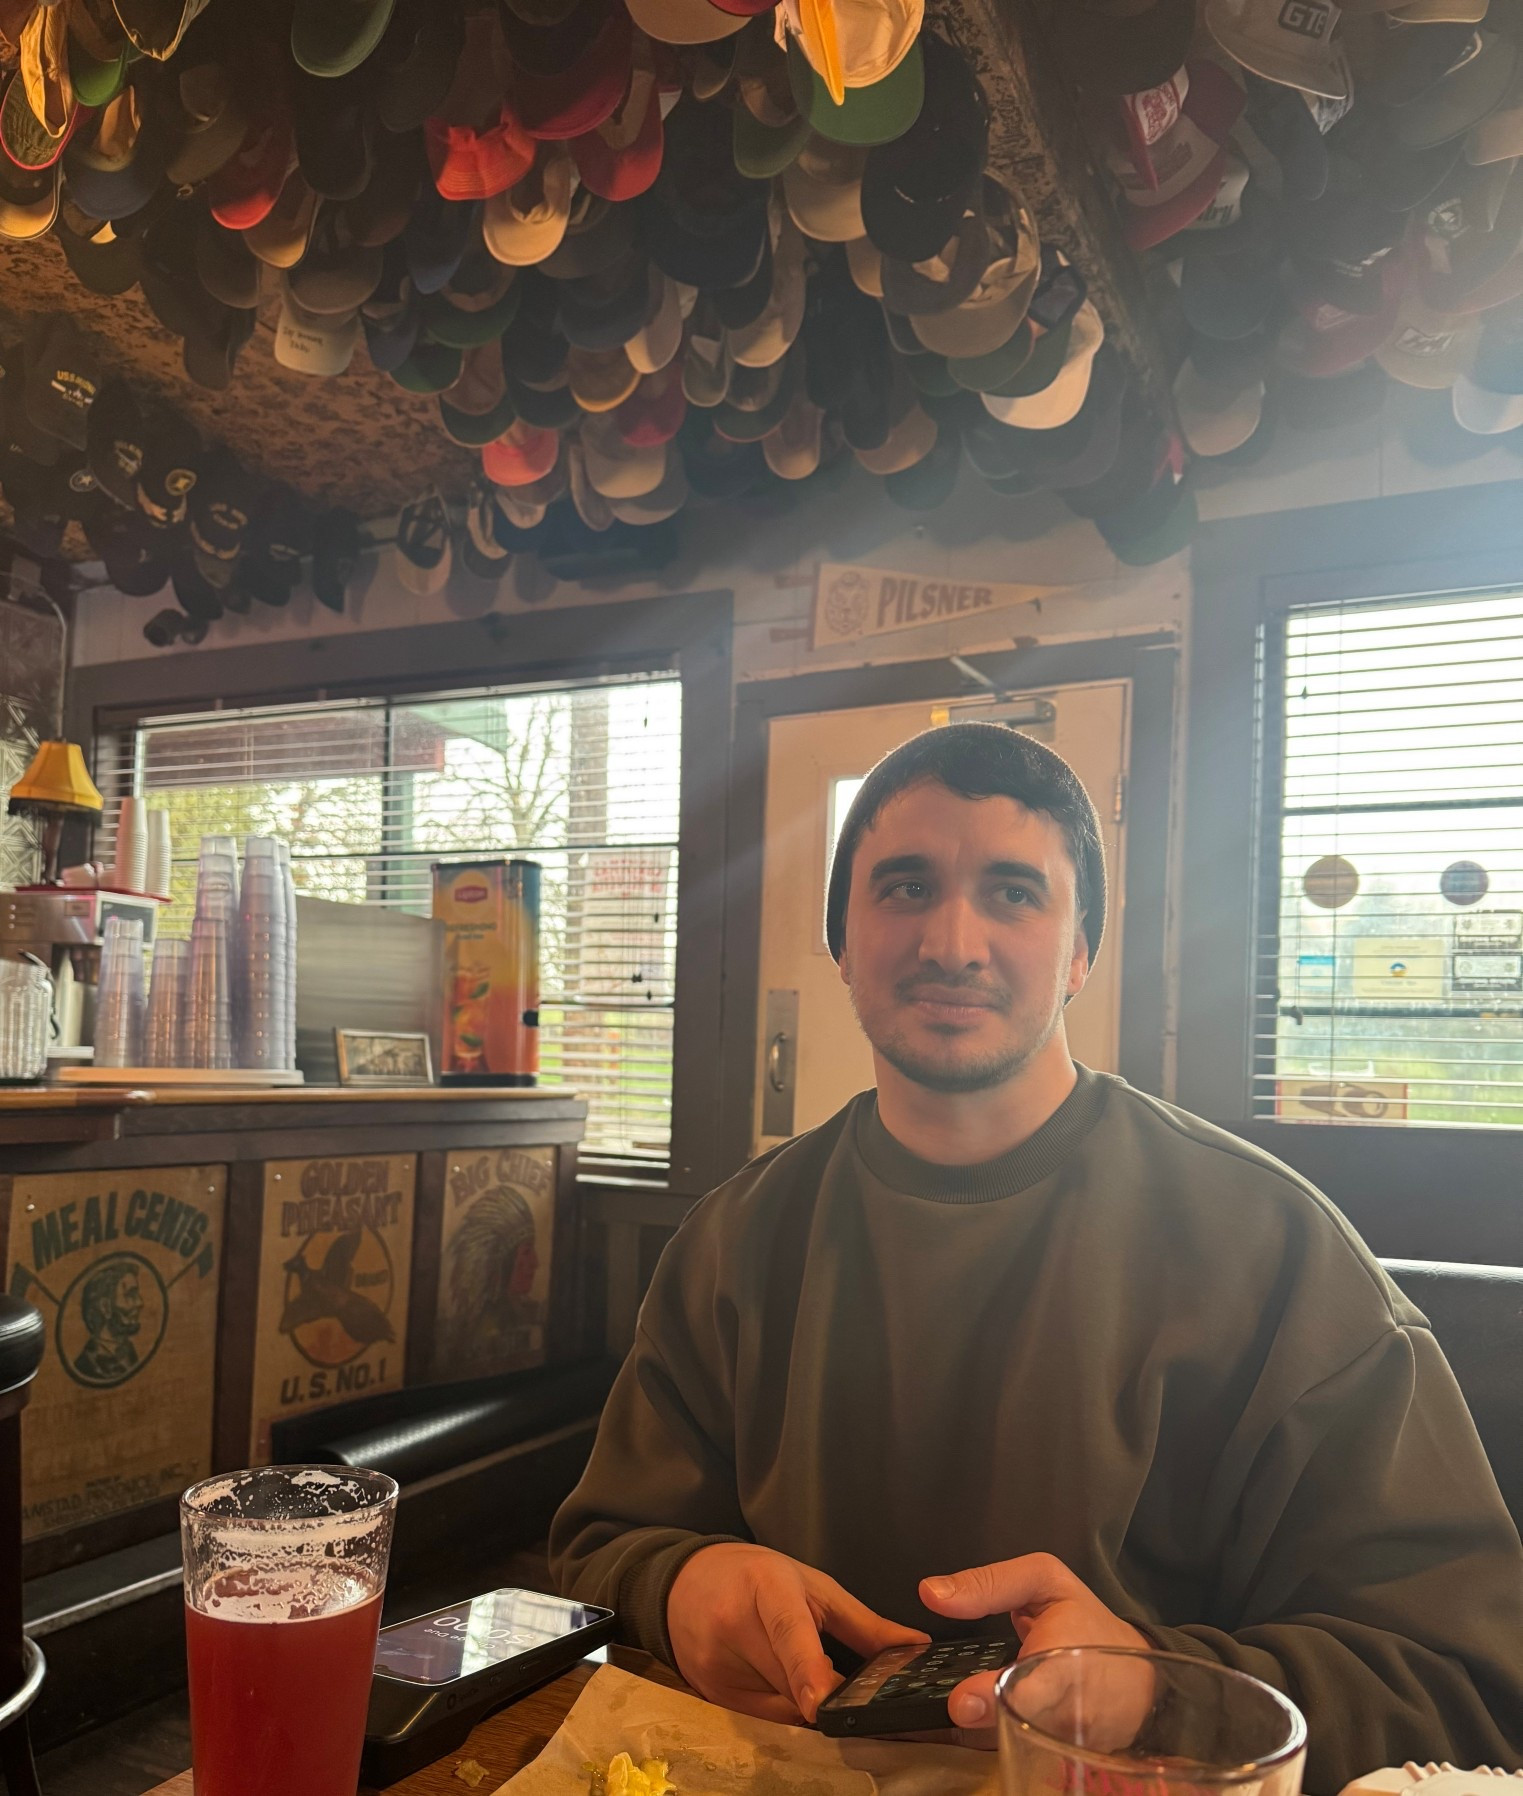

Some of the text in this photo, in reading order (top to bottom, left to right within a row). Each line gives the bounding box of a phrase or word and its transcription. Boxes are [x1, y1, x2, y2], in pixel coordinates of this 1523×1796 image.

[876, 577, 993, 629] PILSNER
[301, 1160, 390, 1198] GOLDEN
[450, 1150, 553, 1208] BIG CHIEF
[32, 1189, 209, 1271] MEAL CENTS
[280, 1190, 403, 1237] PHEASANT
[424, 1628, 450, 1638] Due
